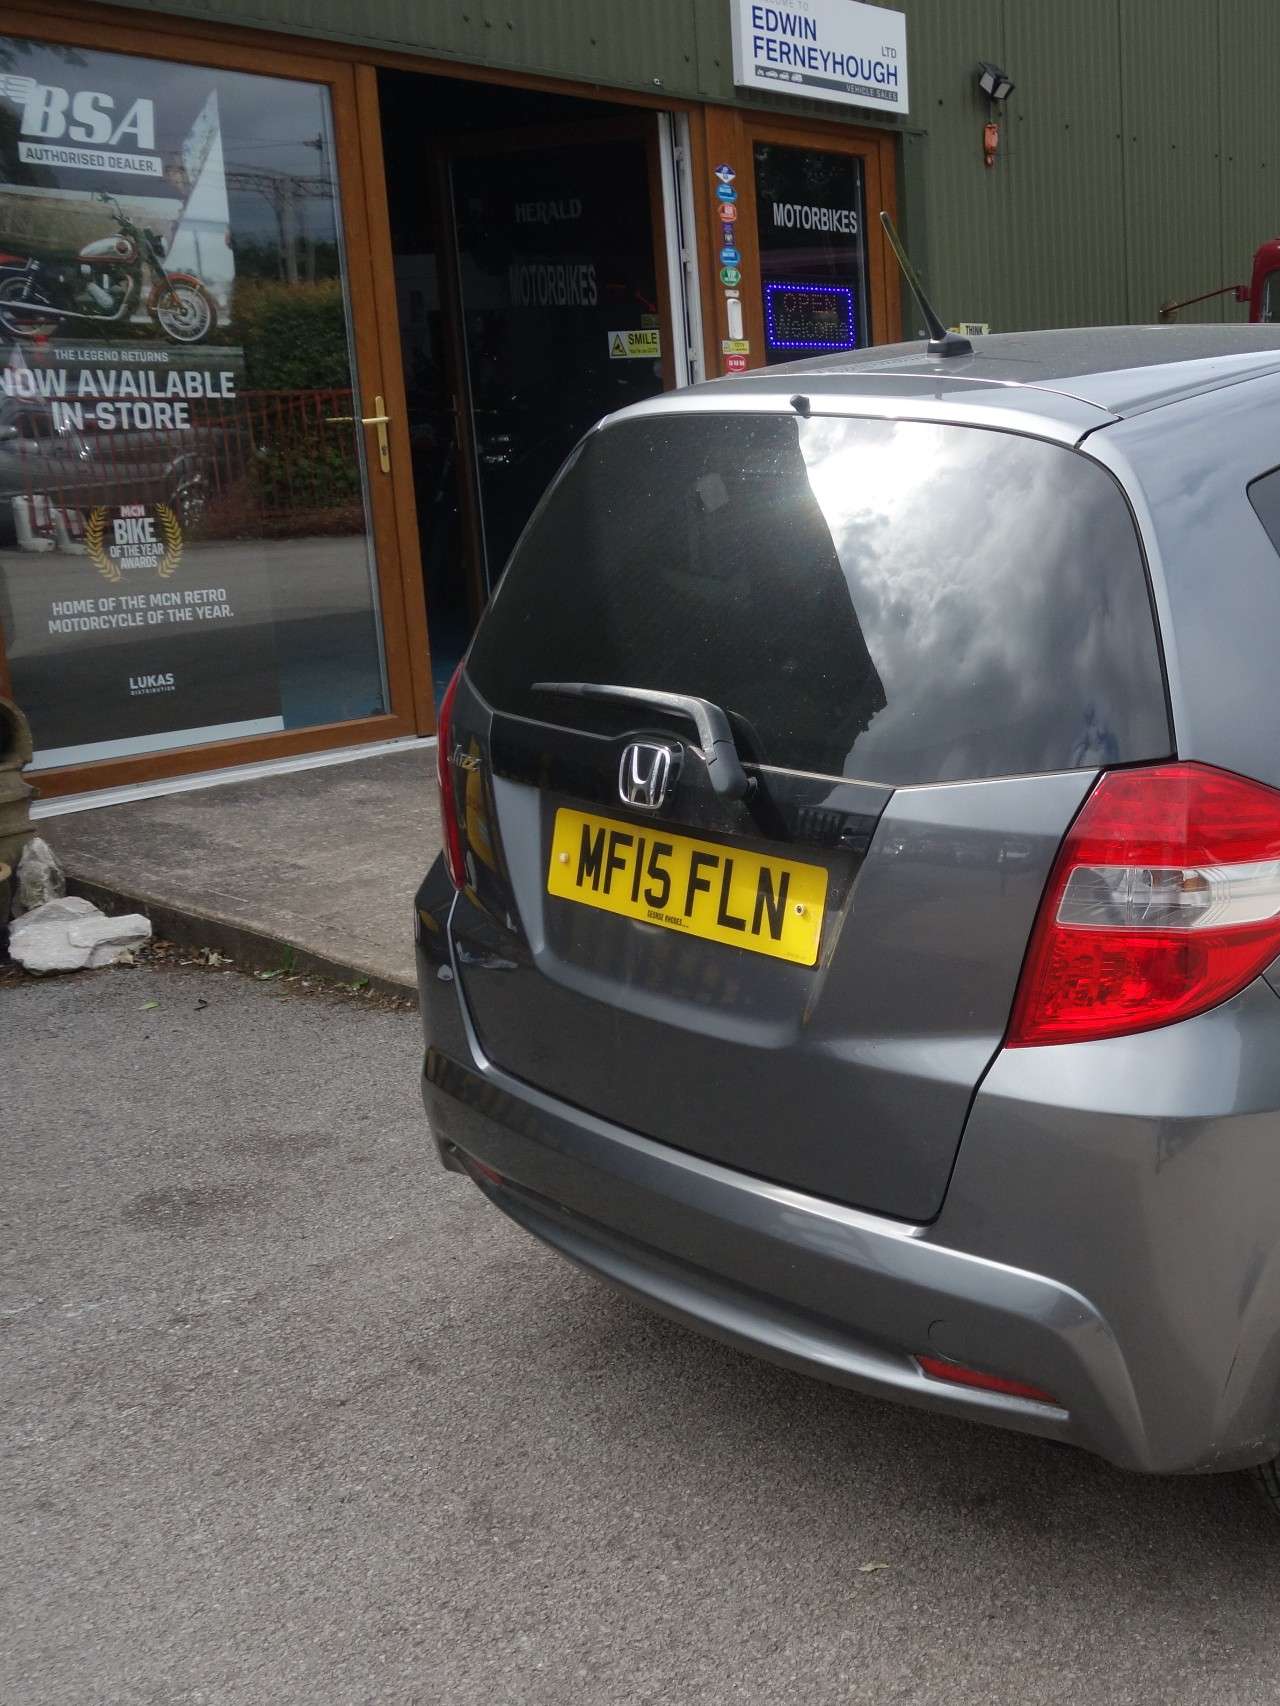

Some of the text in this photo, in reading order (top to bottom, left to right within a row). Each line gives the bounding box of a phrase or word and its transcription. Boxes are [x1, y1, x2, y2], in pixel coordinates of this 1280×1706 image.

[752, 5, 817, 42] EDWIN
[753, 35, 898, 87] FERNEYHOUGH
[882, 46, 897, 59] LTD
[847, 83, 898, 101] VEHICLE SALES
[20, 84, 155, 149] BSA
[26, 147, 105, 166] AUTHORISED
[514, 199, 583, 224] HERALD
[773, 202, 858, 234] MOTORBIKES
[509, 264, 598, 306] MOTORBIKES
[627, 332, 658, 345] SMILE
[54, 349, 169, 362] THE LEGEND RETURNS
[78, 369, 236, 398] AVAILABLE
[51, 401, 191, 430] IN-STORE
[121, 505, 145, 517] MCN
[113, 518, 156, 544] BIKE
[110, 543, 165, 558] OF THE YEAR
[120, 556, 158, 569] AWARDS
[52, 588, 226, 616] HOME OF THE MCN RETRO
[48, 604, 235, 634] MOTORCYCLE OF THE YEAR.
[129, 672, 175, 690] LUKAS
[576, 823, 791, 941] MF15 FLN
